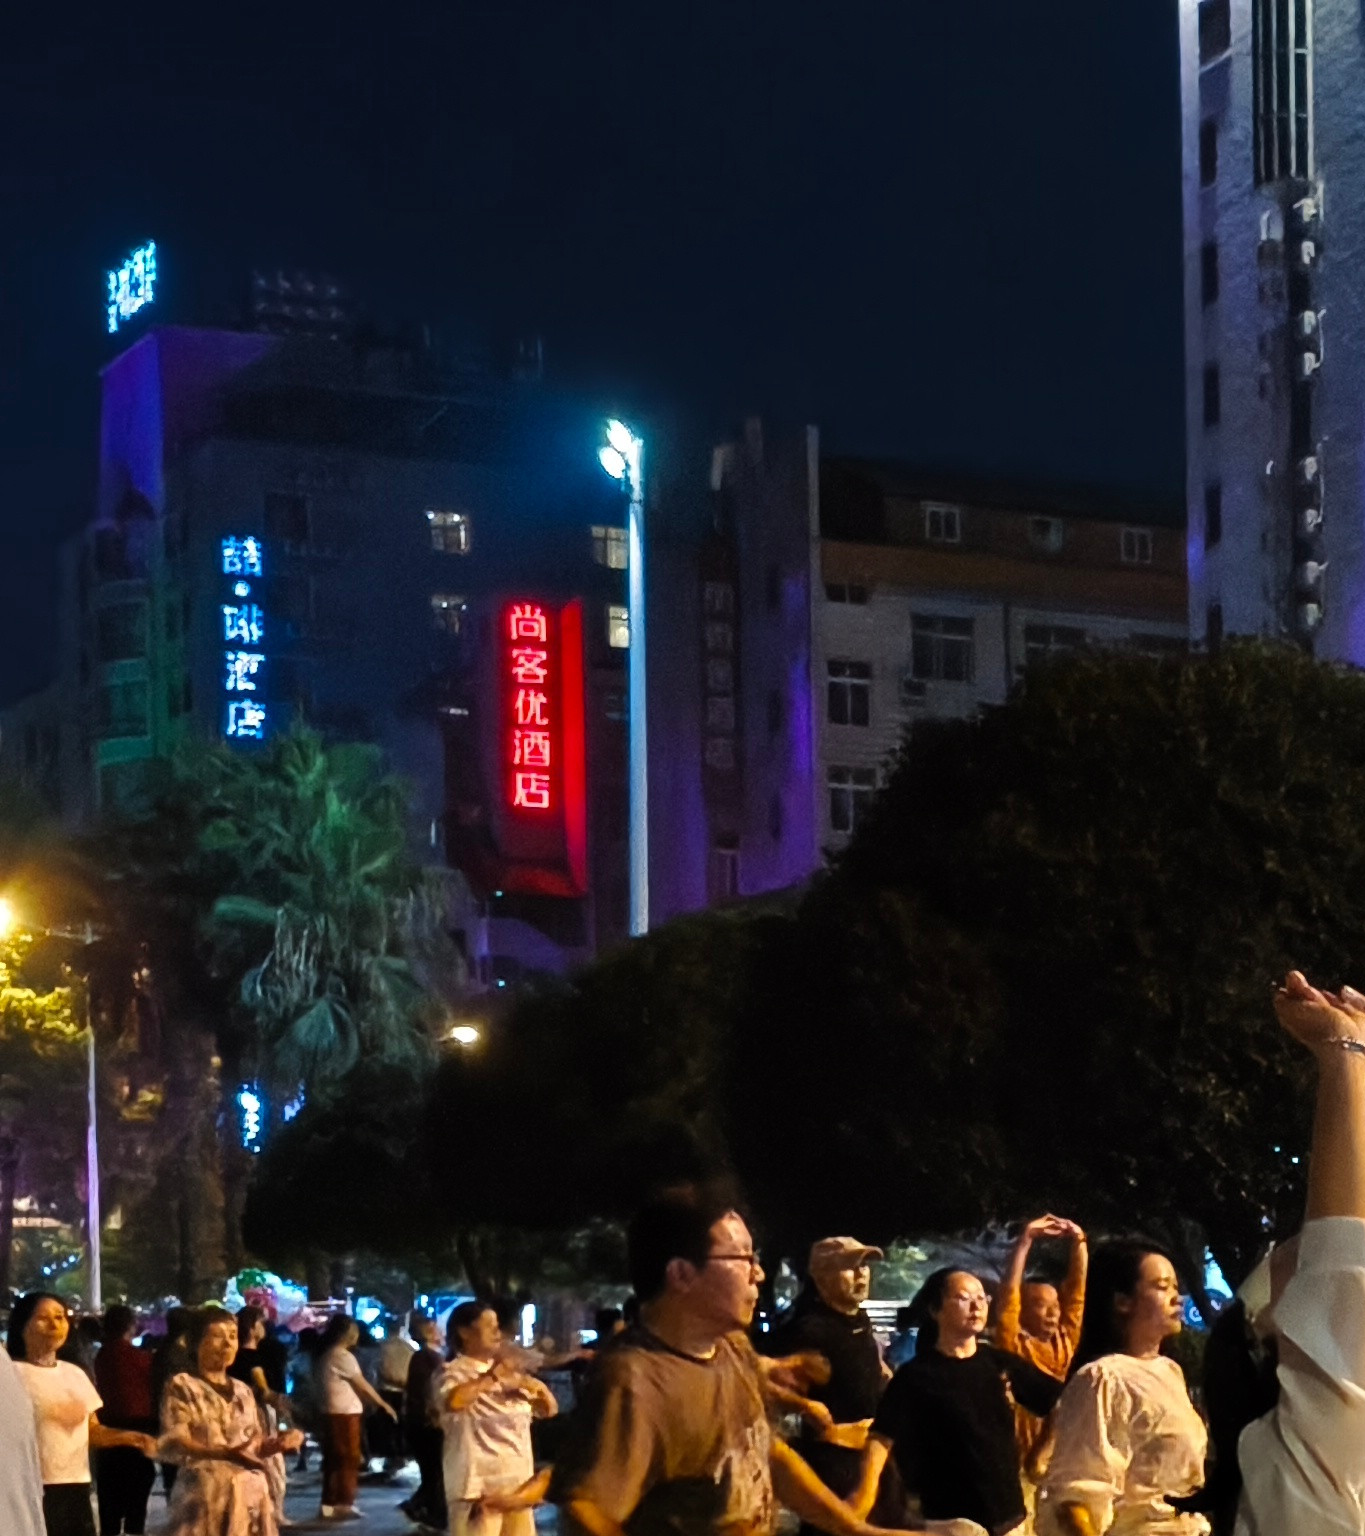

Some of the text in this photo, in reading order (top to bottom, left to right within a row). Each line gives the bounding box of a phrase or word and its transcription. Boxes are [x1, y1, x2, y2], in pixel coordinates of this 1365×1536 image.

[510, 603, 551, 809] 尚客优酒店
